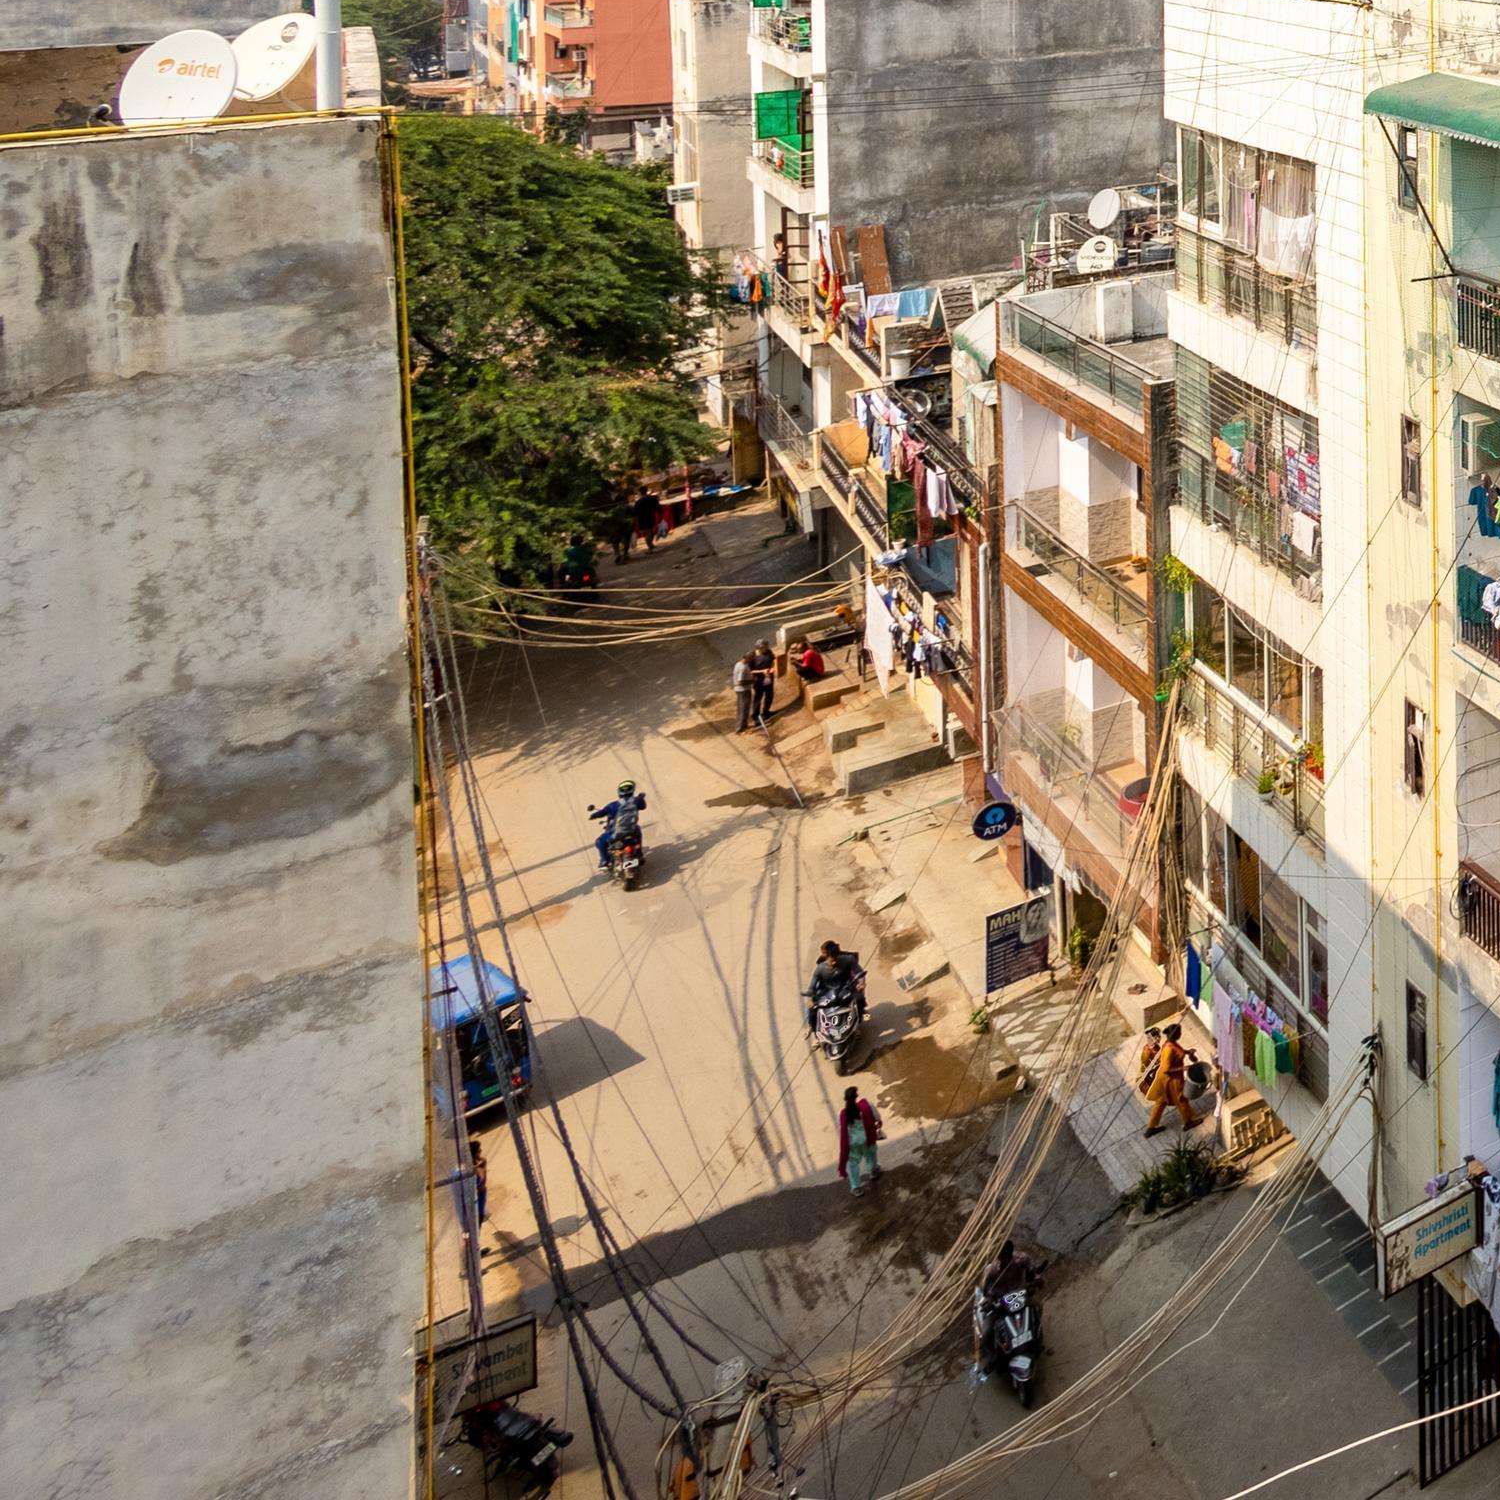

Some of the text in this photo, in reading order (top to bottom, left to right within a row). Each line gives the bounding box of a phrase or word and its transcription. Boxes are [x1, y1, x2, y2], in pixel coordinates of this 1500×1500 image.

[176, 60, 222, 79] airtel
[983, 822, 1007, 837] ATM
[1414, 1218, 1471, 1259] Apartment
